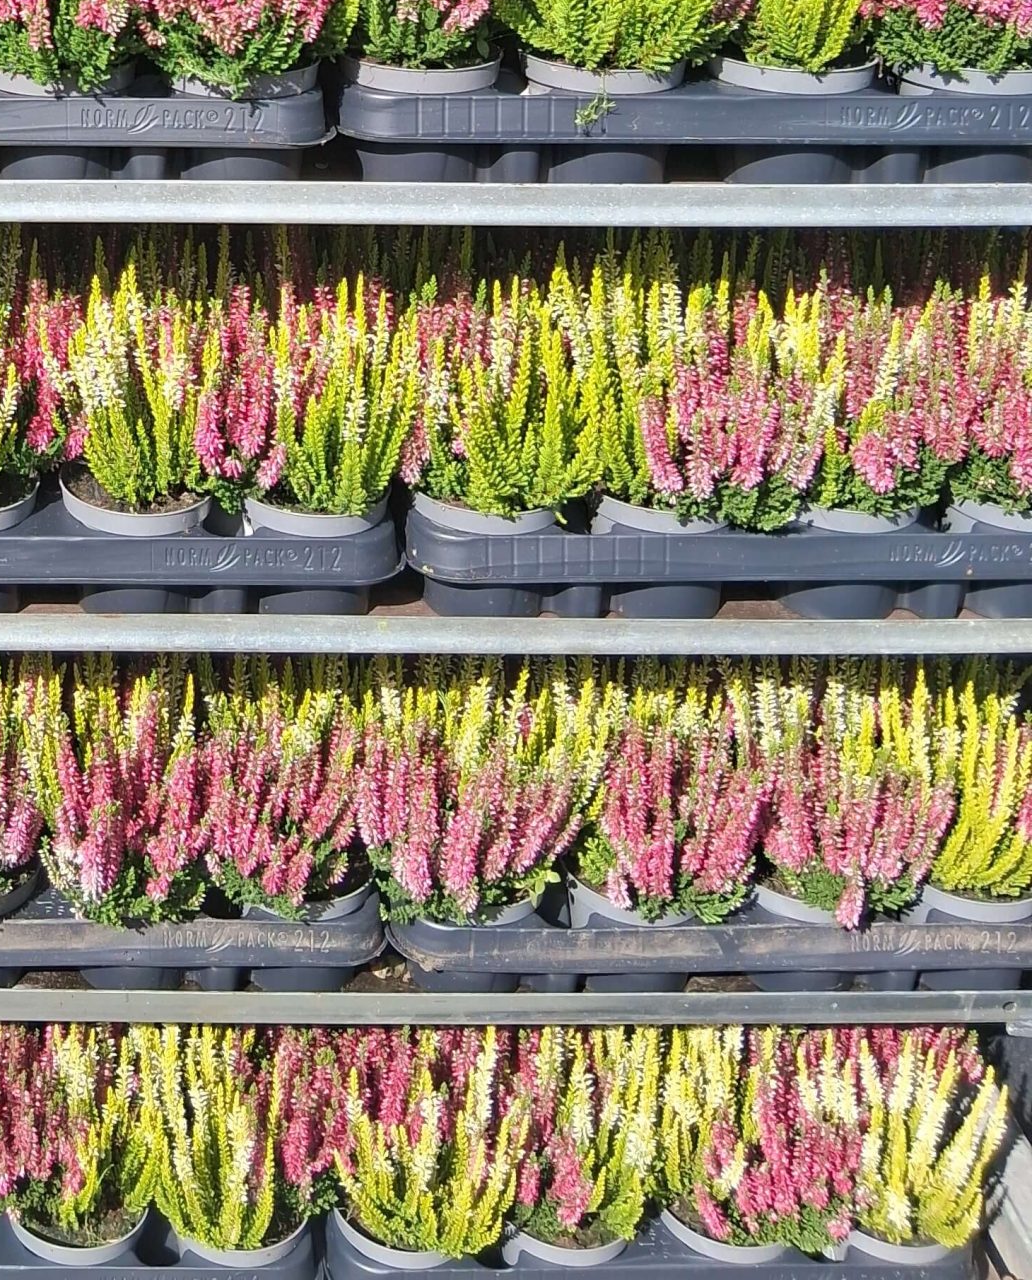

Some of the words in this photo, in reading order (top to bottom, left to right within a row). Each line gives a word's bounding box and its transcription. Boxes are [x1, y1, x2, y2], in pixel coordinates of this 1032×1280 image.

[80, 107, 131, 129] NORM
[224, 106, 265, 134] 212
[840, 106, 892, 128] NORM
[989, 103, 1032, 131] 212
[165, 547, 213, 567] NORM
[303, 545, 342, 571] 212
[889, 543, 938, 563] NORM
[163, 930, 207, 948] NORM
[294, 929, 330, 954] 212
[851, 933, 895, 952] NORM
[980, 930, 1018, 955] 212
